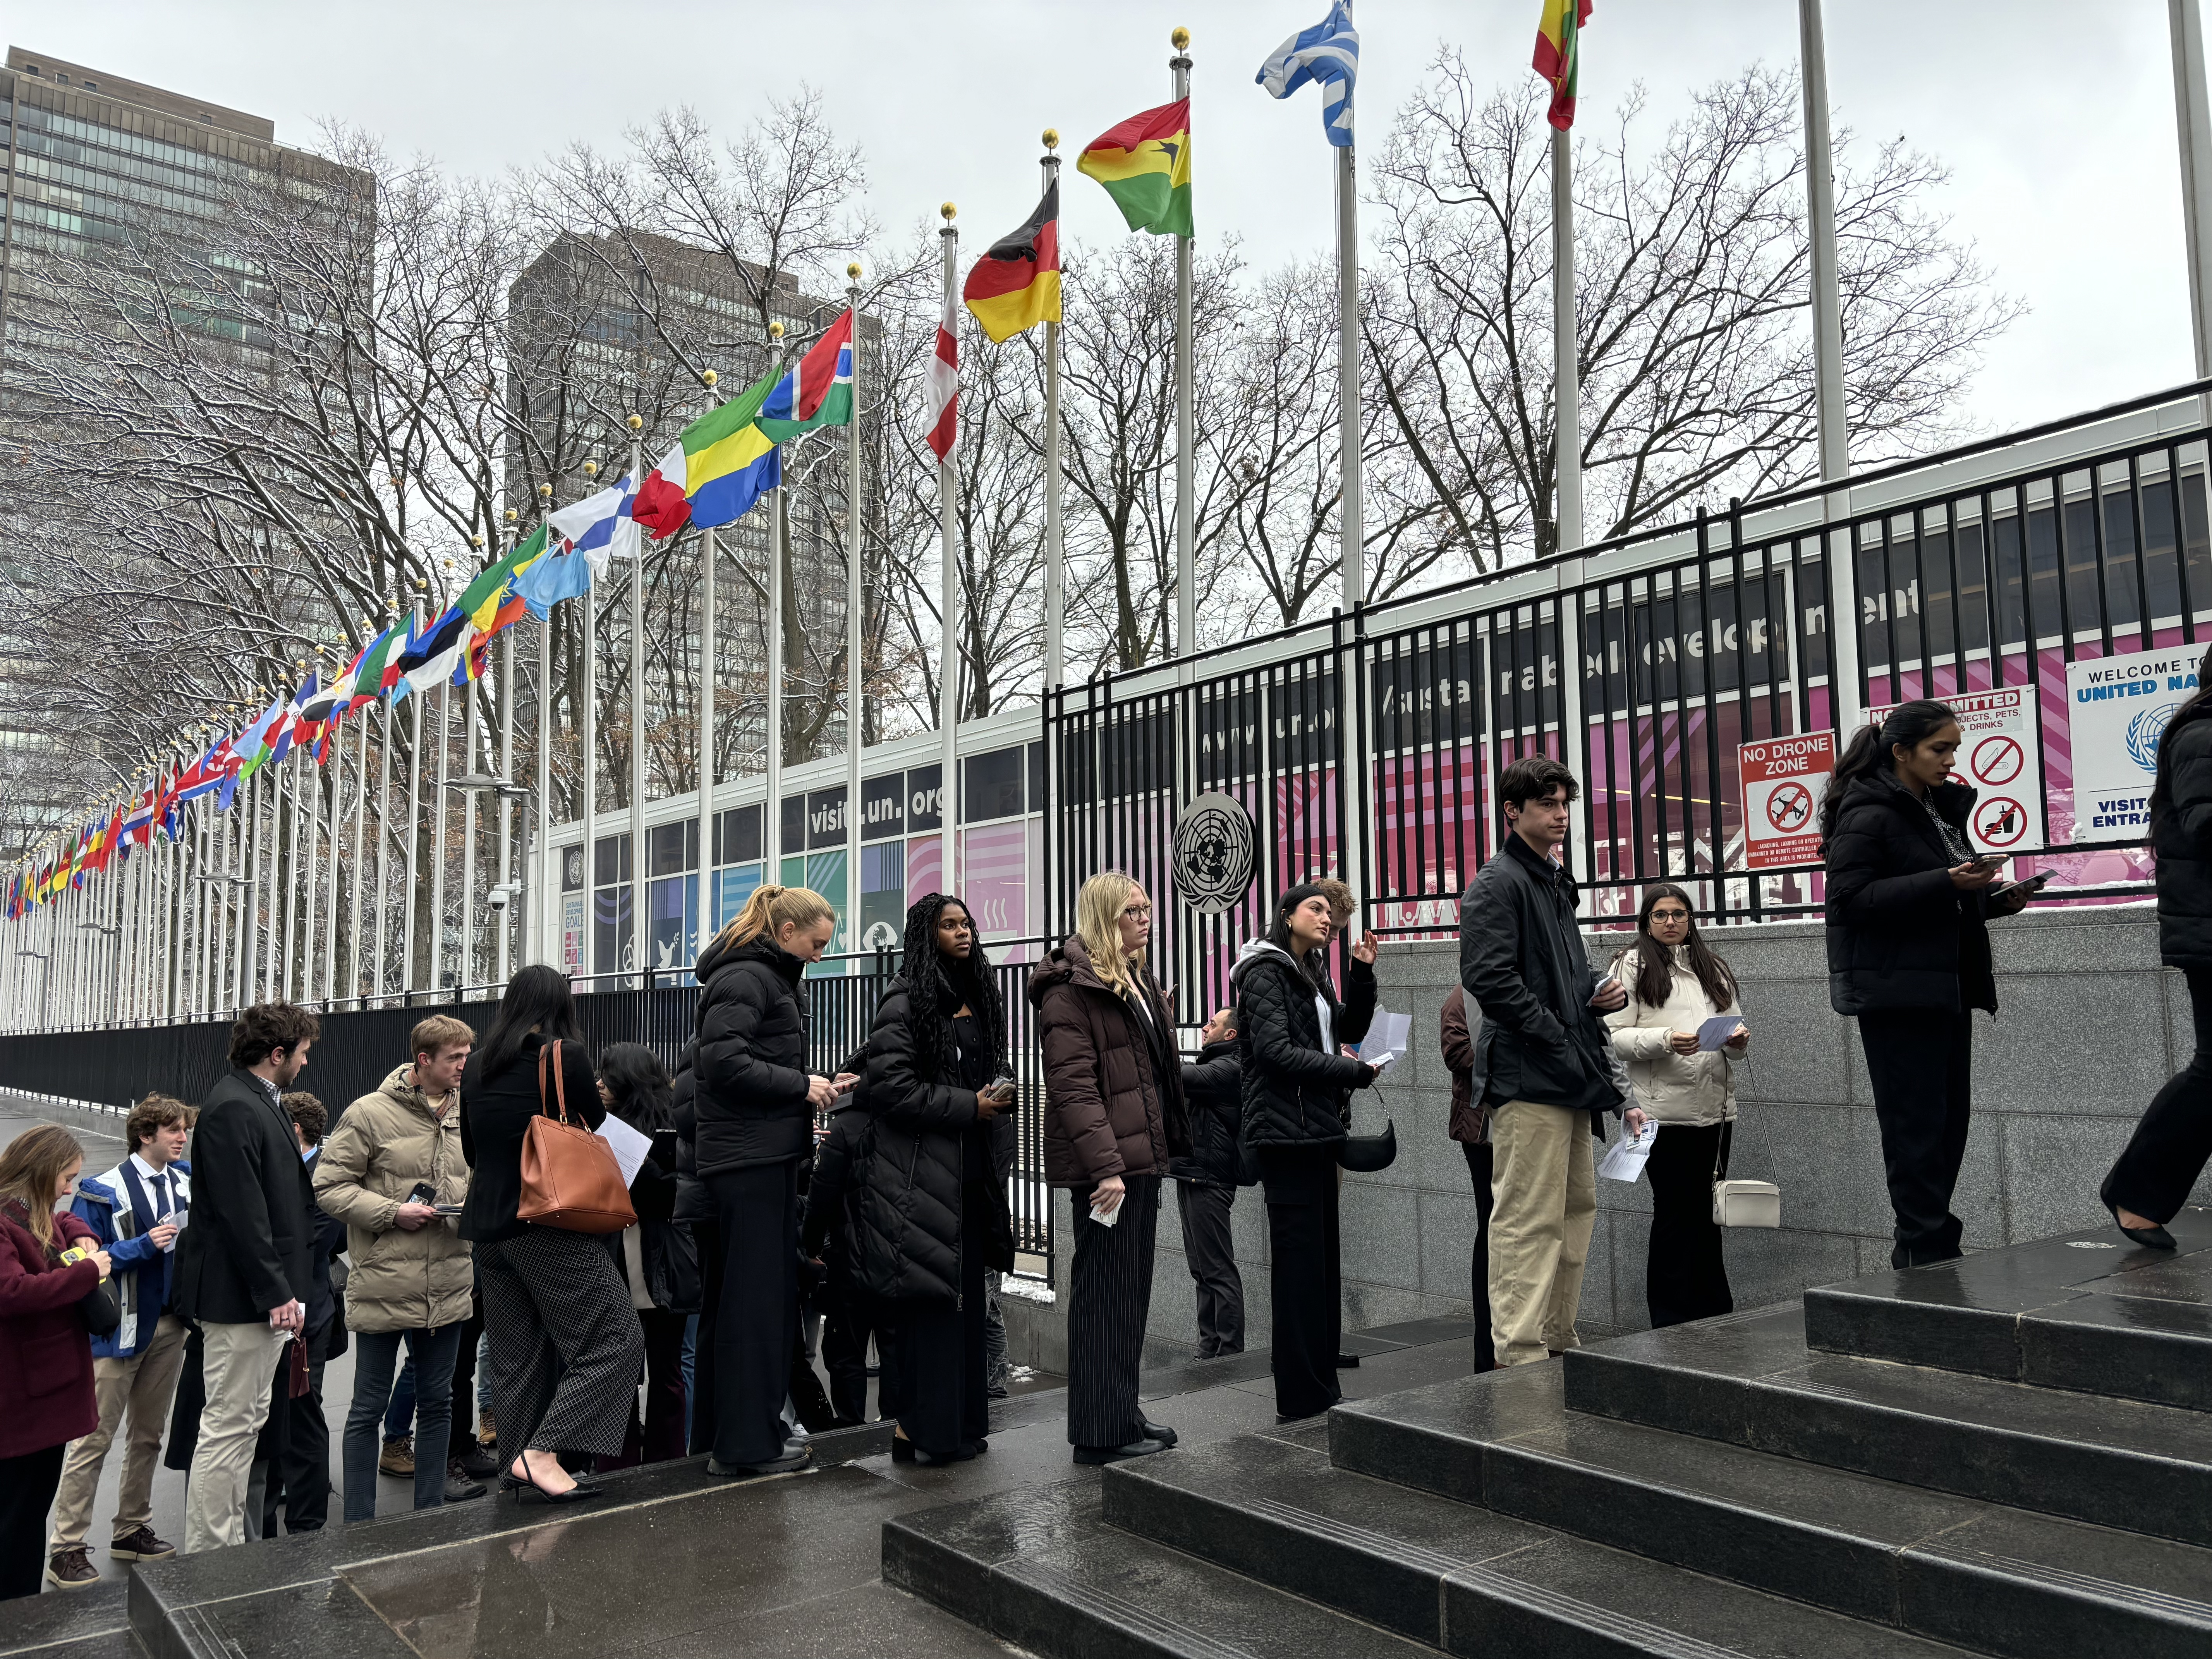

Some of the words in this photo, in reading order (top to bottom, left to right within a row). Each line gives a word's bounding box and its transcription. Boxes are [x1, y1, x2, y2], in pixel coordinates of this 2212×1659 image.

[2088, 659, 2181, 683] WELCOME
[2077, 680, 2157, 703] UNITED
[2167, 673, 2199, 691] NA
[1942, 692, 2018, 712] MITTED
[1957, 713, 1992, 723] BJECTS,
[1996, 709, 2021, 718] PETS,
[1970, 720, 2003, 731] DRINKS
[1744, 748, 1766, 763] NO
[1772, 737, 1829, 758] DRONE
[1765, 757, 1808, 775] ZONE
[2098, 797, 2147, 813] VISIT
[2092, 812, 2151, 828] ENTRA
[1792, 845, 1817, 853] CONTROLLED
